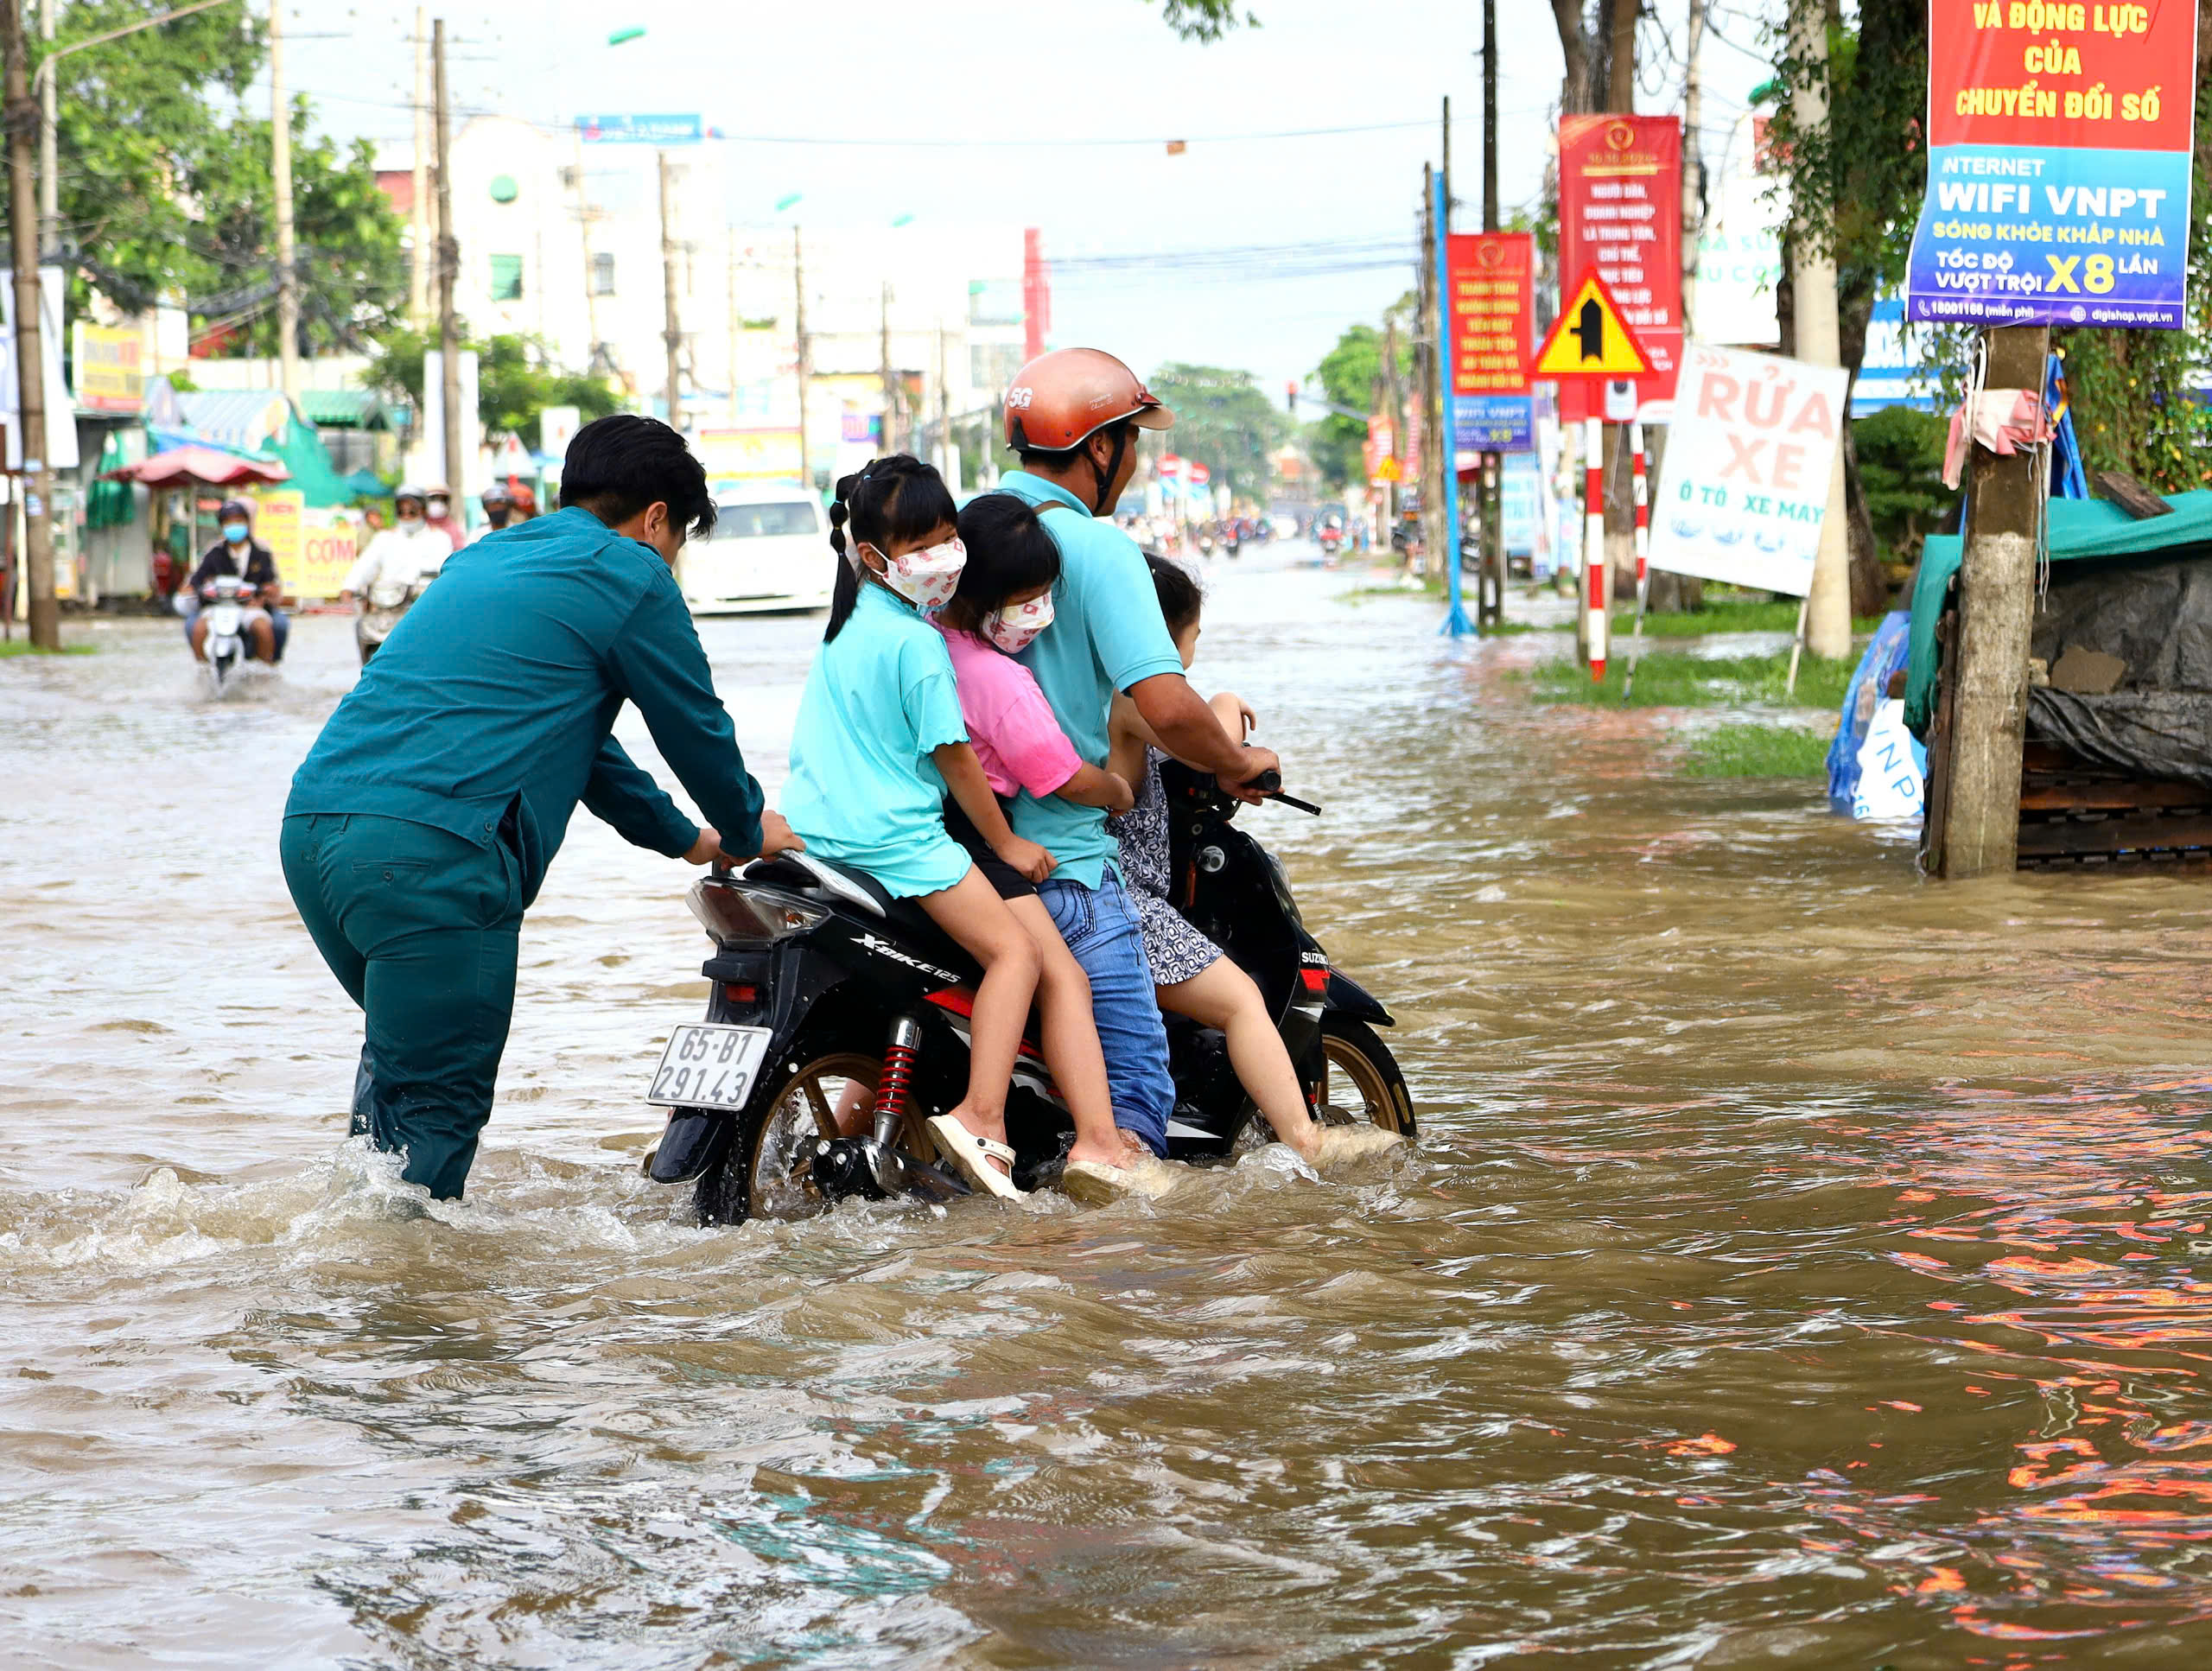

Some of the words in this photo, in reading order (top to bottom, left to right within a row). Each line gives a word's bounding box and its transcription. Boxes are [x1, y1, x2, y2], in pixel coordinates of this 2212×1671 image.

[2009, 0, 2086, 35] ĐỘNG
[2094, 3, 2149, 38] LỰC
[2024, 38, 2082, 74] CỦA
[1955, 79, 2057, 118] CHUYỂN
[2064, 83, 2113, 120] ĐỔI
[2121, 86, 2163, 122] SỐ
[1938, 182, 2031, 214] WIFI
[2044, 185, 2167, 219] VNPT
[1932, 218, 1993, 240] SÓNG
[1936, 246, 1979, 269] TỐC
[1982, 251, 2014, 274] ĐỘ
[2044, 253, 2115, 295] X8
[1936, 270, 1992, 294] VƯỢT
[1995, 270, 2043, 295] TRỘI
[1008, 387, 1033, 408] 5G
[1697, 364, 1834, 439] RỬA
[1719, 433, 1806, 490] XE
[1679, 480, 1693, 501] Ô
[1700, 485, 1727, 507] TÔ
[1743, 493, 1771, 515] XE
[652, 1065, 748, 1104] 291.43
